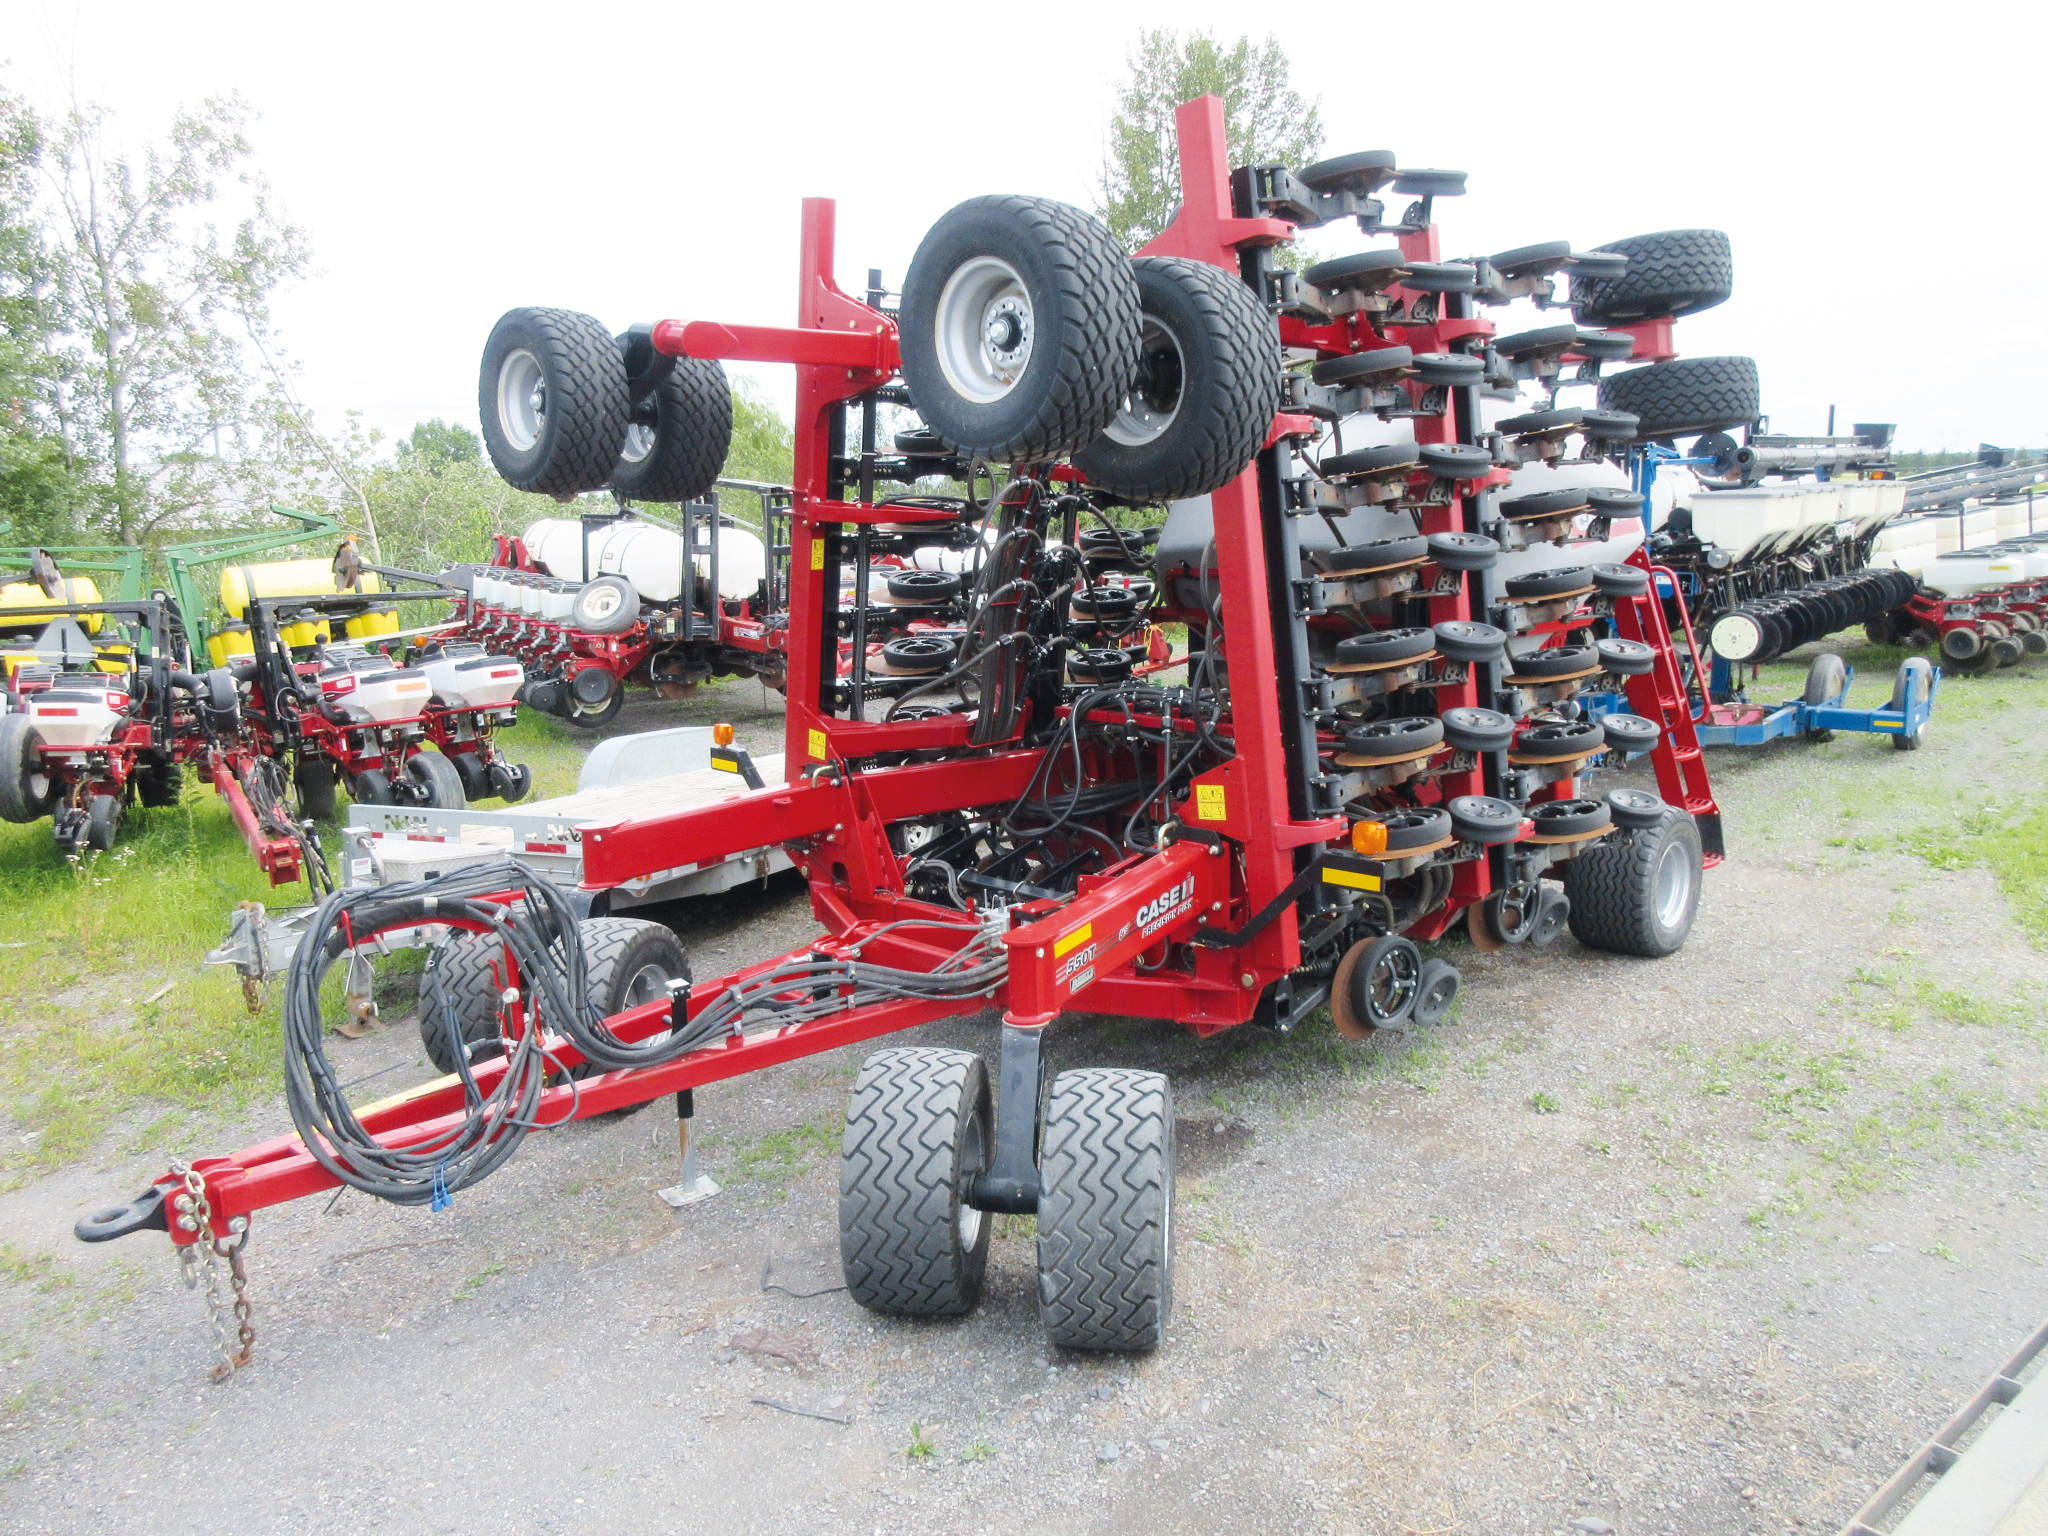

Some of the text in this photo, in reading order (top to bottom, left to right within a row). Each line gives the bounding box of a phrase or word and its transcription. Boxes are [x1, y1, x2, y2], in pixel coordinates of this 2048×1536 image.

[336, 678, 352, 689] WHITE
[1136, 884, 1181, 927] CASE
[1142, 907, 1177, 939] PRECISION
[1177, 897, 1193, 916] DISK
[1066, 943, 1097, 977] 550T
